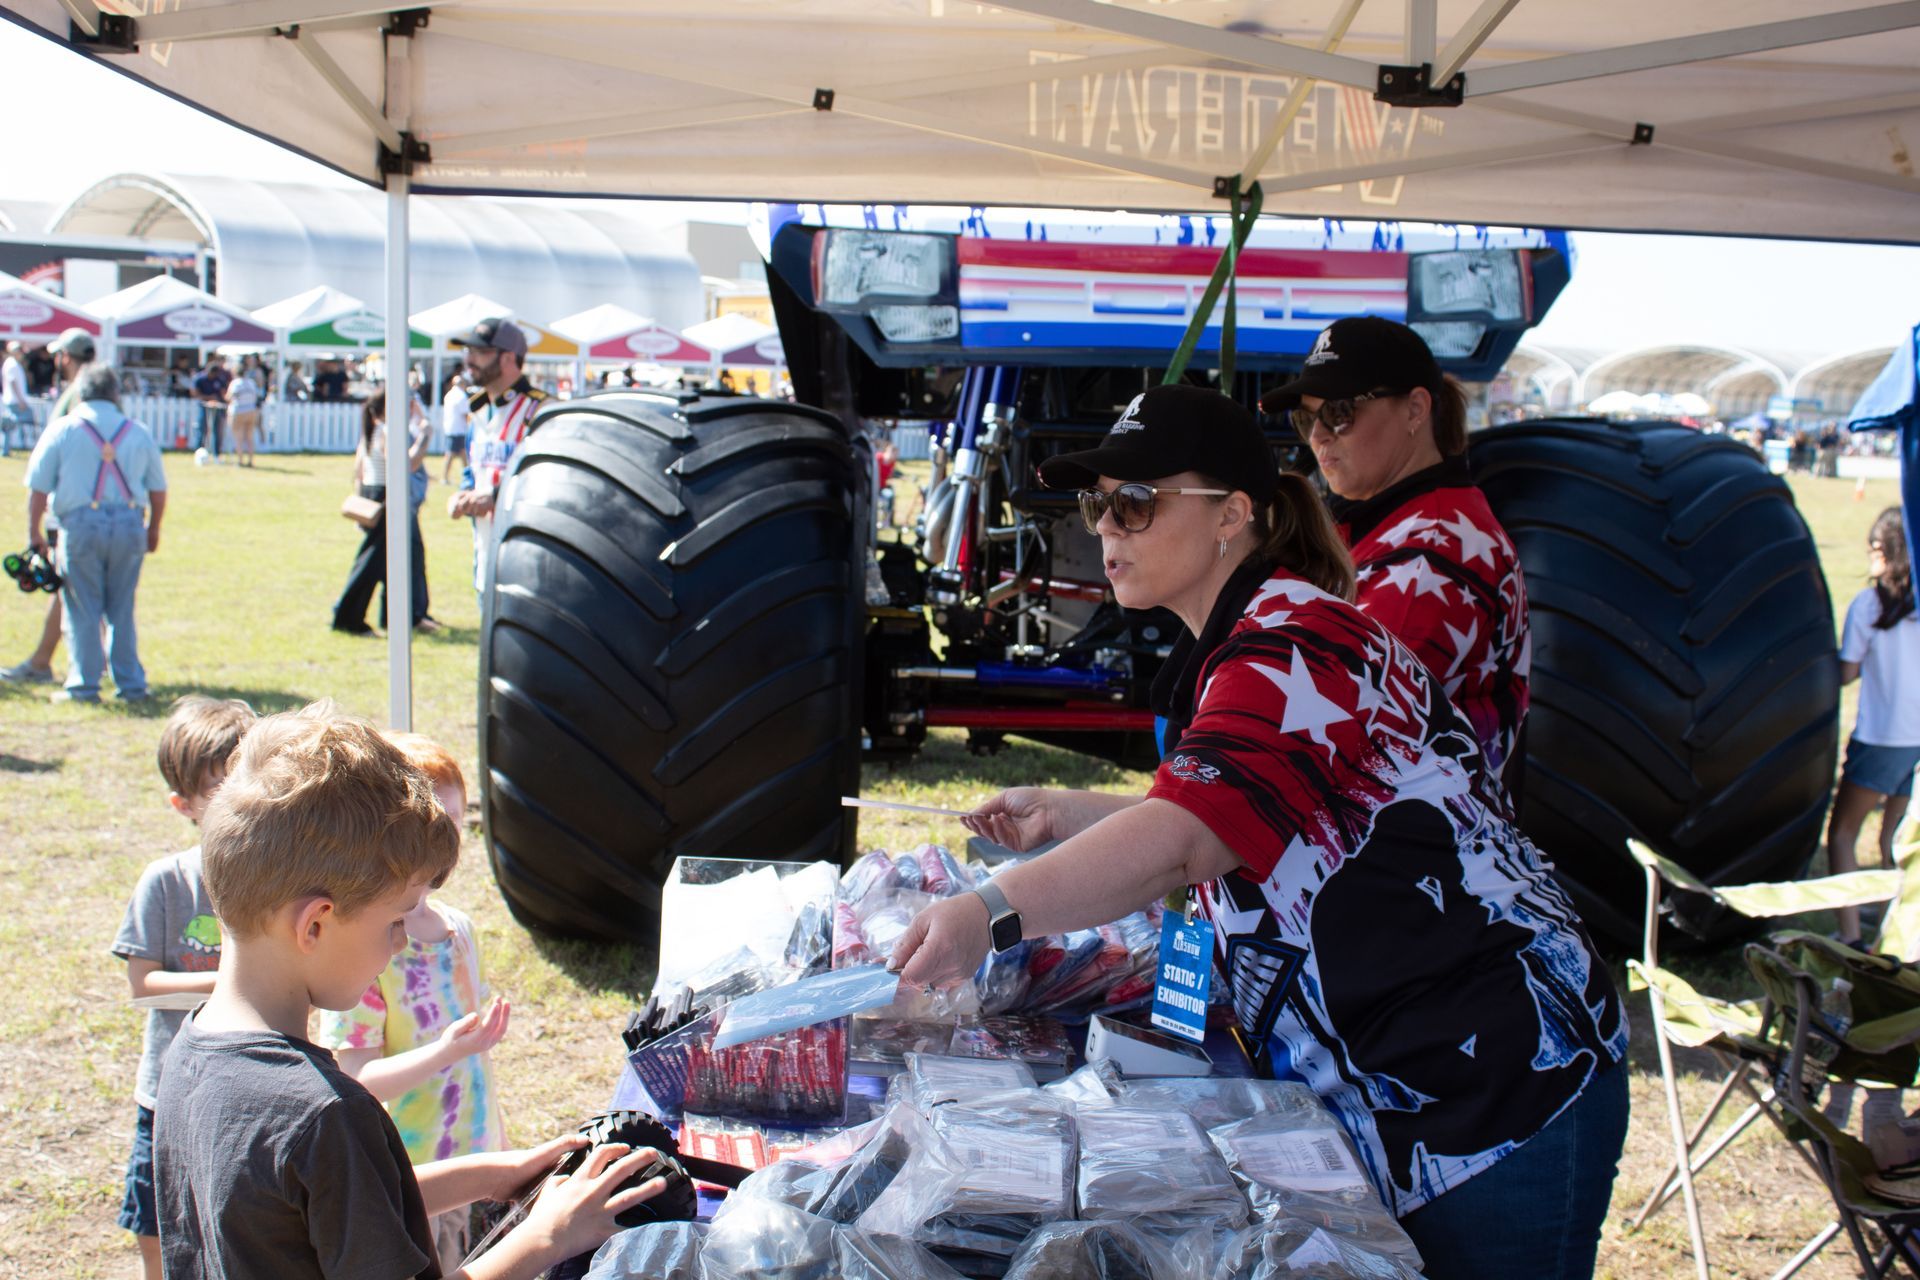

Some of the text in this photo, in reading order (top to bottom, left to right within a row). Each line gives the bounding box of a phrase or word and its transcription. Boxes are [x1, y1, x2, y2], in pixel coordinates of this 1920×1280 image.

[1163, 963, 1205, 991] STATIC /
[1157, 985, 1206, 1017] EXHIBITOR
